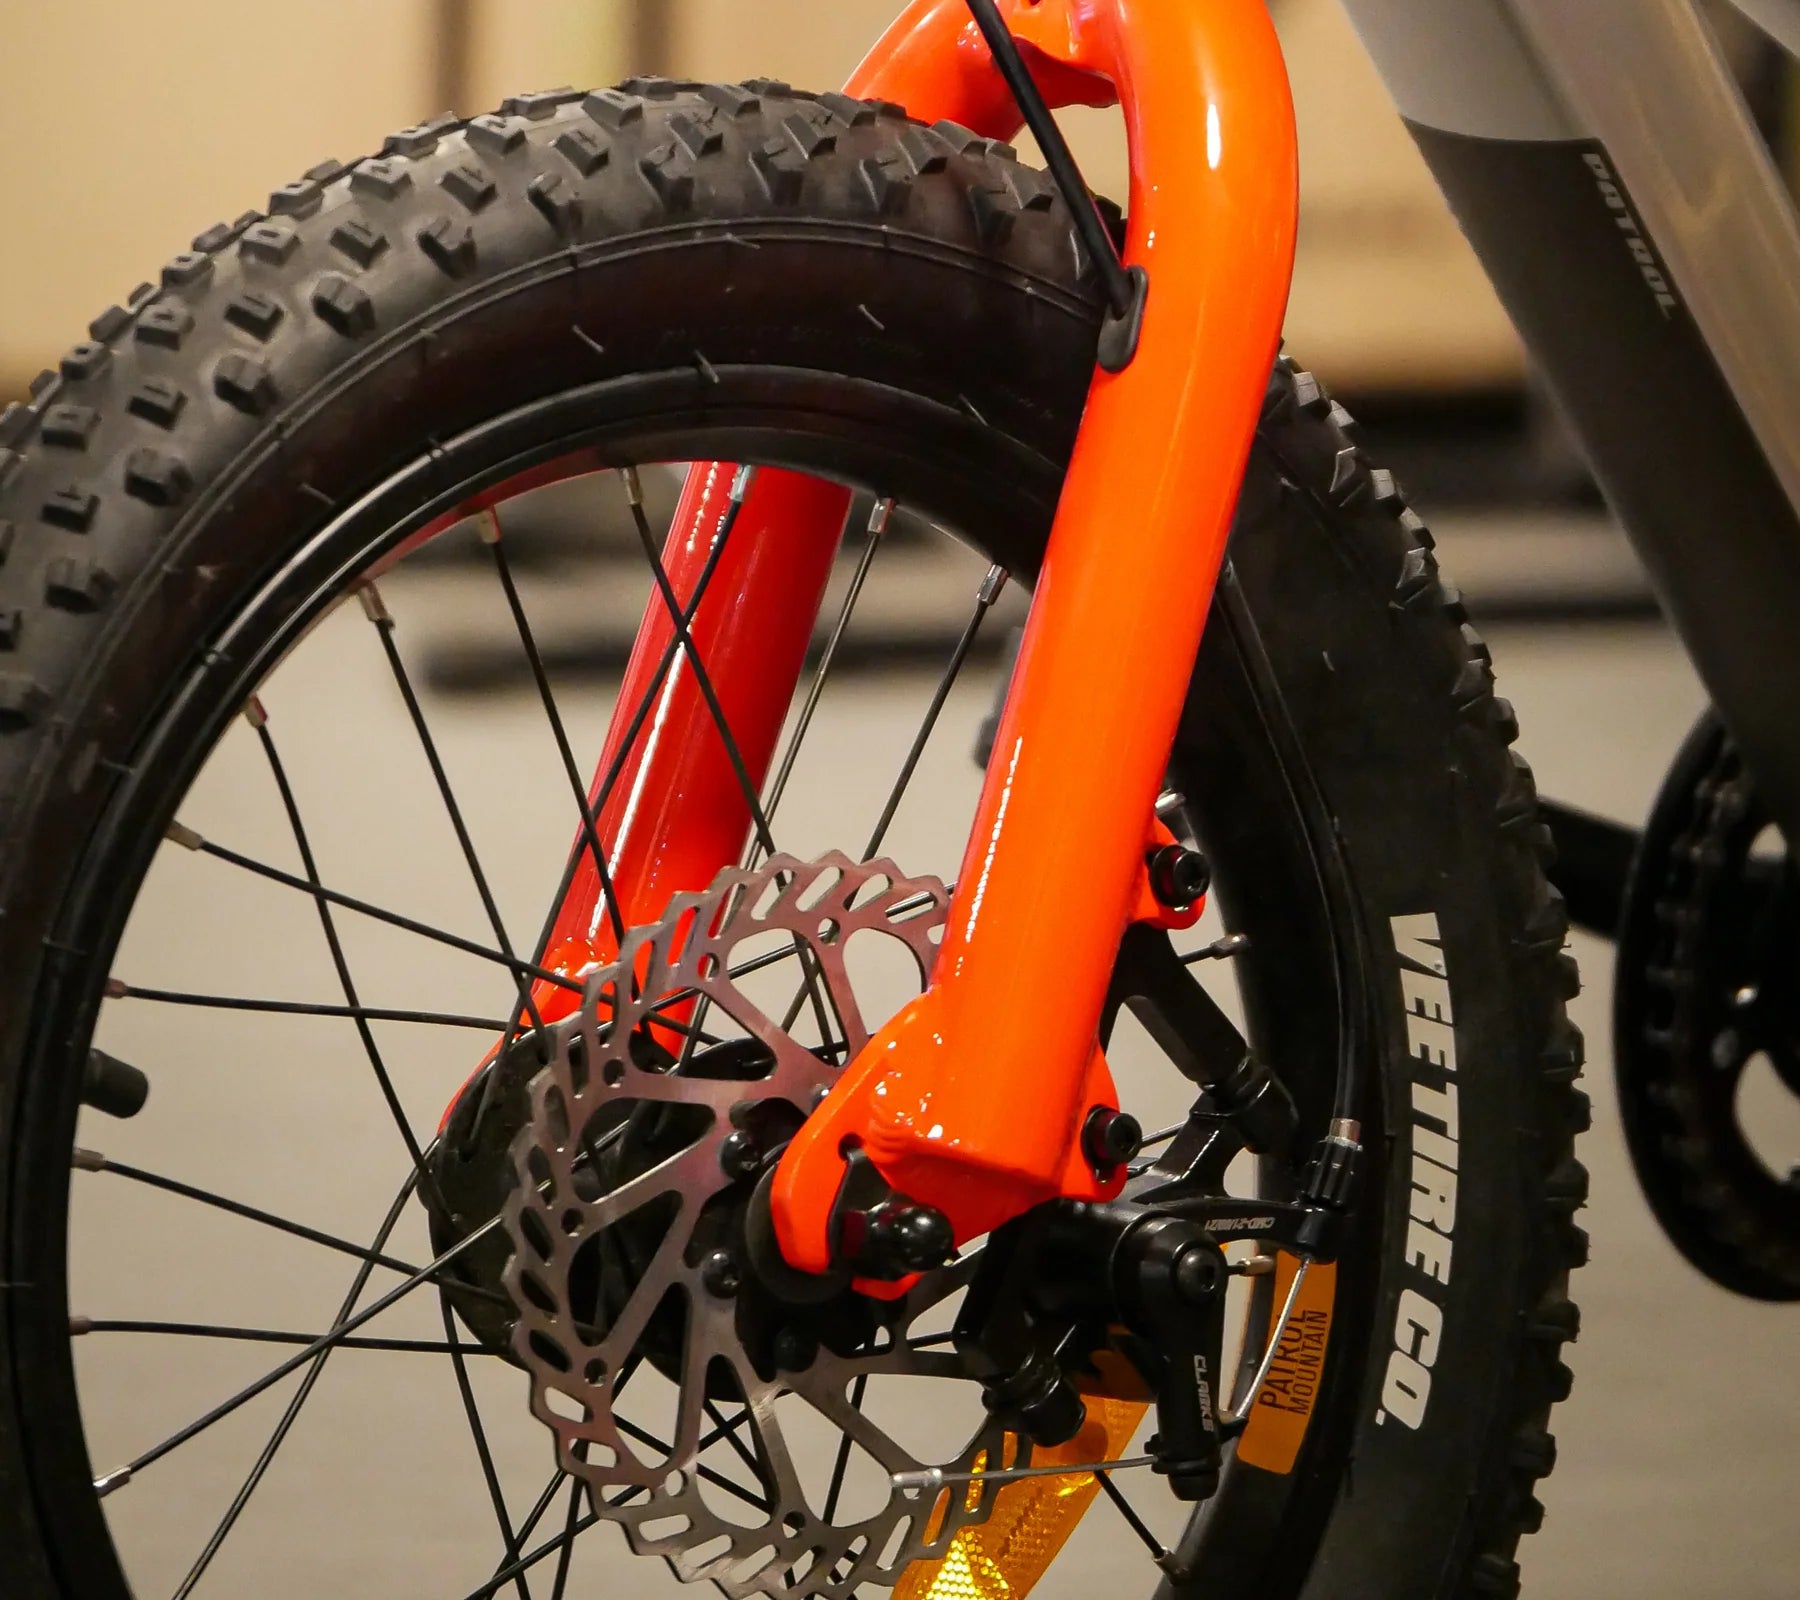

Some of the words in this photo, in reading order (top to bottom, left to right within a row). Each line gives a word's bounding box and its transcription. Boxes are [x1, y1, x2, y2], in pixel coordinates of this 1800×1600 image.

[1582, 154, 1676, 320] PATROL
[1389, 911, 1457, 1071] VEE
[1405, 1081, 1459, 1286] TIRE
[1287, 1310, 1328, 1416] MOUNTAIN
[1374, 1288, 1443, 1431] CO.
